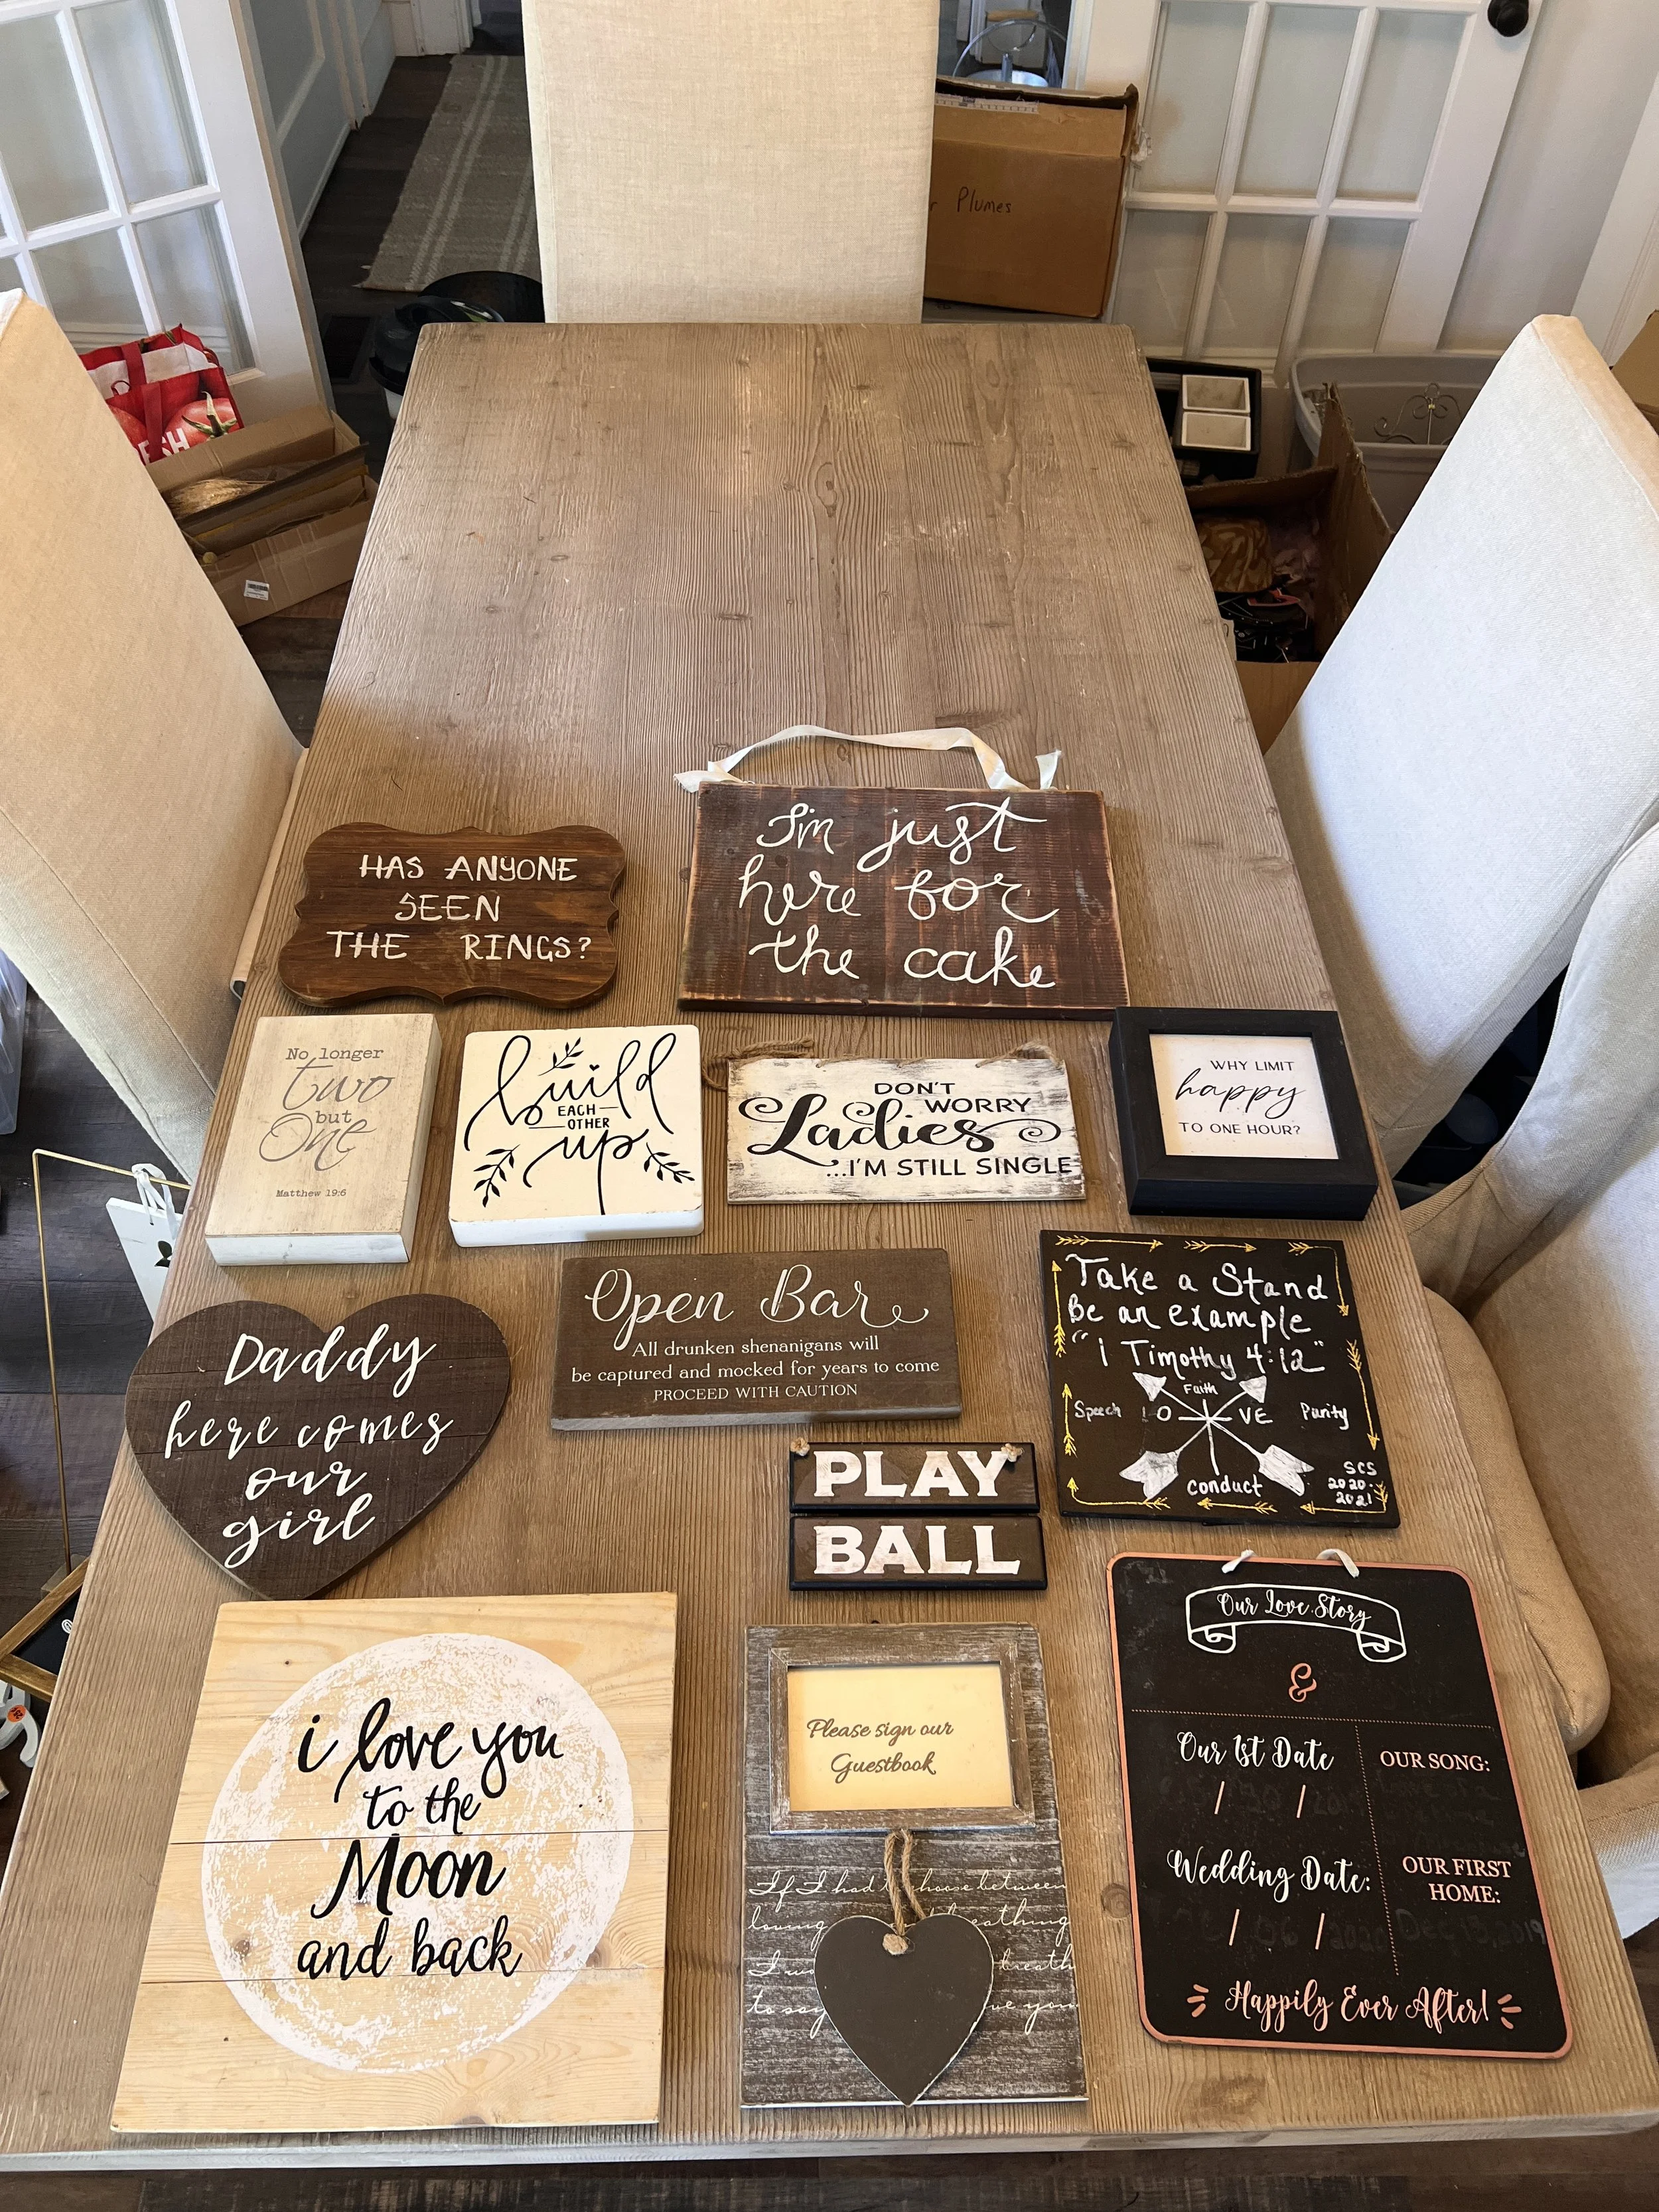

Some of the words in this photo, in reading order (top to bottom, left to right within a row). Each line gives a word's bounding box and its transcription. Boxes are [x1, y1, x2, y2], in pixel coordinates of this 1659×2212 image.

[957, 186, 1012, 213] Plumes
[756, 802, 834, 854] I'm
[857, 796, 1047, 872] just
[359, 854, 424, 879] HAS
[444, 855, 578, 881] ANYONE
[395, 892, 500, 922] SEEN
[738, 853, 861, 926] here
[895, 869, 1059, 923] for
[326, 930, 409, 959] THE
[460, 933, 592, 962] RINGS?
[749, 924, 859, 979] the
[903, 926, 1055, 988] cake
[285, 1048, 309, 1060] No
[319, 1048, 384, 1062] longer
[1210, 1061, 1248, 1070] WHY
[1256, 1061, 1295, 1071] LIMIT
[283, 1057, 396, 1110] two
[464, 1033, 676, 1151] build
[874, 1082, 956, 1095] DON'T
[1175, 1067, 1306, 1120] happy
[315, 1110, 352, 1124] but
[557, 1104, 596, 1117] EACH
[567, 1118, 610, 1130] OTHER
[924, 1097, 1032, 1113] WORRY
[259, 1112, 377, 1171] One
[738, 1093, 1062, 1168] Ladies
[1179, 1122, 1203, 1133] TO
[1210, 1123, 1241, 1134] ONE
[1247, 1124, 1301, 1135] HOUR?
[523, 1129, 650, 1215] up
[897, 1157, 967, 1176] STILL
[975, 1155, 1072, 1175] SINGLE
[1065, 1253, 1158, 1295] Take
[1178, 1274, 1198, 1292] a
[1212, 1262, 1328, 1305] Stand
[584, 1268, 735, 1351] Open
[760, 1264, 929, 1328] Bar
[1067, 1293, 1104, 1323] Be
[1118, 1304, 1161, 1329] an
[1168, 1303, 1312, 1344] example
[224, 1323, 437, 1398] Daddy
[632, 1341, 658, 1357] All
[664, 1340, 735, 1356] drunken
[741, 1337, 842, 1358] shenanigans
[849, 1335, 879, 1351] will
[1121, 1339, 1234, 1380] Timothy
[571, 1367, 591, 1383] be
[597, 1364, 673, 1387] captured
[679, 1363, 711, 1380] and
[717, 1360, 784, 1378] mocked
[790, 1360, 816, 1376] for
[822, 1361, 868, 1380] years
[873, 1359, 889, 1374] to
[895, 1360, 940, 1374] come
[654, 1388, 729, 1402] PROCEED
[735, 1386, 779, 1400] WITH
[785, 1384, 858, 1398] CAUTION
[1184, 1382, 1218, 1395] Faith
[1074, 1399, 1122, 1419] Speech
[1300, 1402, 1350, 1432] Purity
[164, 1400, 279, 1460] here
[297, 1410, 454, 1455] comes
[244, 1461, 368, 1501] our
[814, 1451, 1010, 1497] PLAY
[1343, 1461, 1378, 1476] SCS
[1336, 1491, 1372, 1507] 2021
[222, 1493, 376, 1569] girl
[814, 1525, 1021, 1575] BALL
[1216, 1592, 1259, 1617] Our
[1264, 1589, 1310, 1617] Love
[1315, 1593, 1372, 1631] Story
[1288, 1662, 1317, 1703] &
[297, 1714, 339, 1773] i
[333, 1698, 463, 1803] love
[472, 1722, 564, 1799] you
[806, 1718, 871, 1738] Please
[875, 1722, 916, 1747] sign
[920, 1722, 954, 1735] our
[1177, 1730, 1227, 1765] Our
[1271, 1736, 1334, 1771] Date
[831, 1751, 937, 1784] Guestbook
[1380, 1750, 1425, 1769] OUR
[1428, 1753, 1491, 1772] SONG:
[363, 1785, 414, 1830] to
[425, 1777, 481, 1836] the
[311, 1833, 507, 1919] Moon
[1166, 1846, 1295, 1903] Wedding
[1300, 1855, 1371, 1893] Date:
[1402, 1855, 1449, 1876] OUR
[1453, 1858, 1512, 1878] FIRST
[749, 1870, 796, 1913] If
[795, 1870, 828, 1895] I
[831, 1869, 875, 1894] had
[976, 1869, 1067, 1891] between
[1428, 1882, 1502, 1904] HOME:
[297, 1917, 393, 1980] and
[411, 1915, 523, 1977] back
[748, 1905, 829, 1953] loving
[748, 1949, 781, 1977] I
[998, 1943, 1076, 1971] breath
[747, 1989, 775, 2015] to
[782, 2006, 828, 2040] say
[1225, 1978, 1333, 2033] Happily
[1340, 1984, 1398, 2022] Ever
[1405, 1986, 1490, 2035] After!
